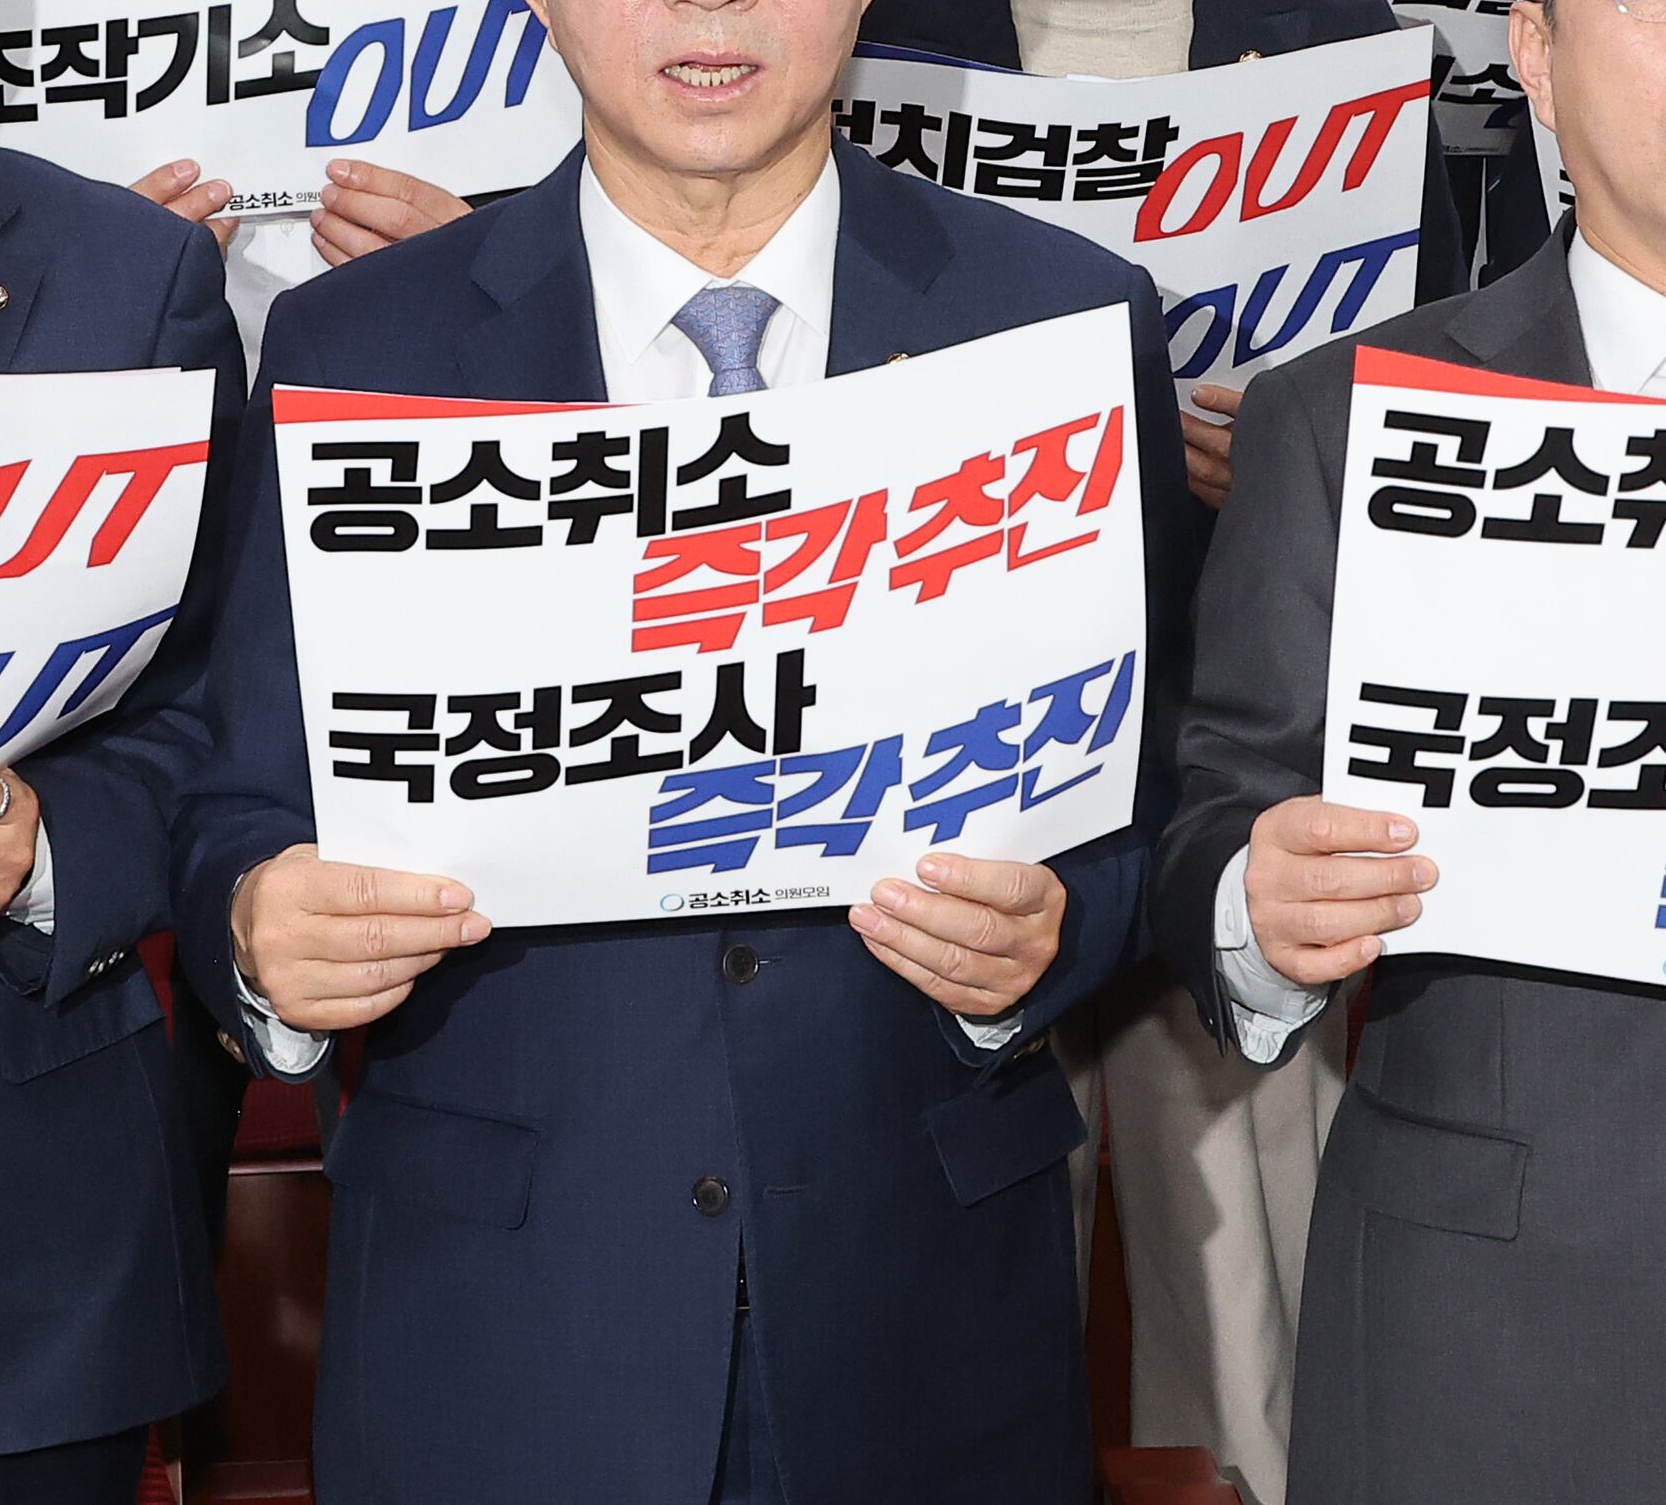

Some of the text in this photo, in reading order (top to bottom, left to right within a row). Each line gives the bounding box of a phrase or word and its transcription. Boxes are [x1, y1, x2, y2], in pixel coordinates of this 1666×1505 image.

[228, 191, 294, 211] 공소취소
[1133, 79, 1433, 244] OUT
[1163, 229, 1422, 380] OUT
[307, 411, 793, 553] 공소취소
[630, 404, 1126, 655] 즉각 추진
[327, 648, 817, 804] 국정조사
[645, 650, 1137, 876] 즉각 추진
[688, 886, 831, 910] 공소취소 의원모임
